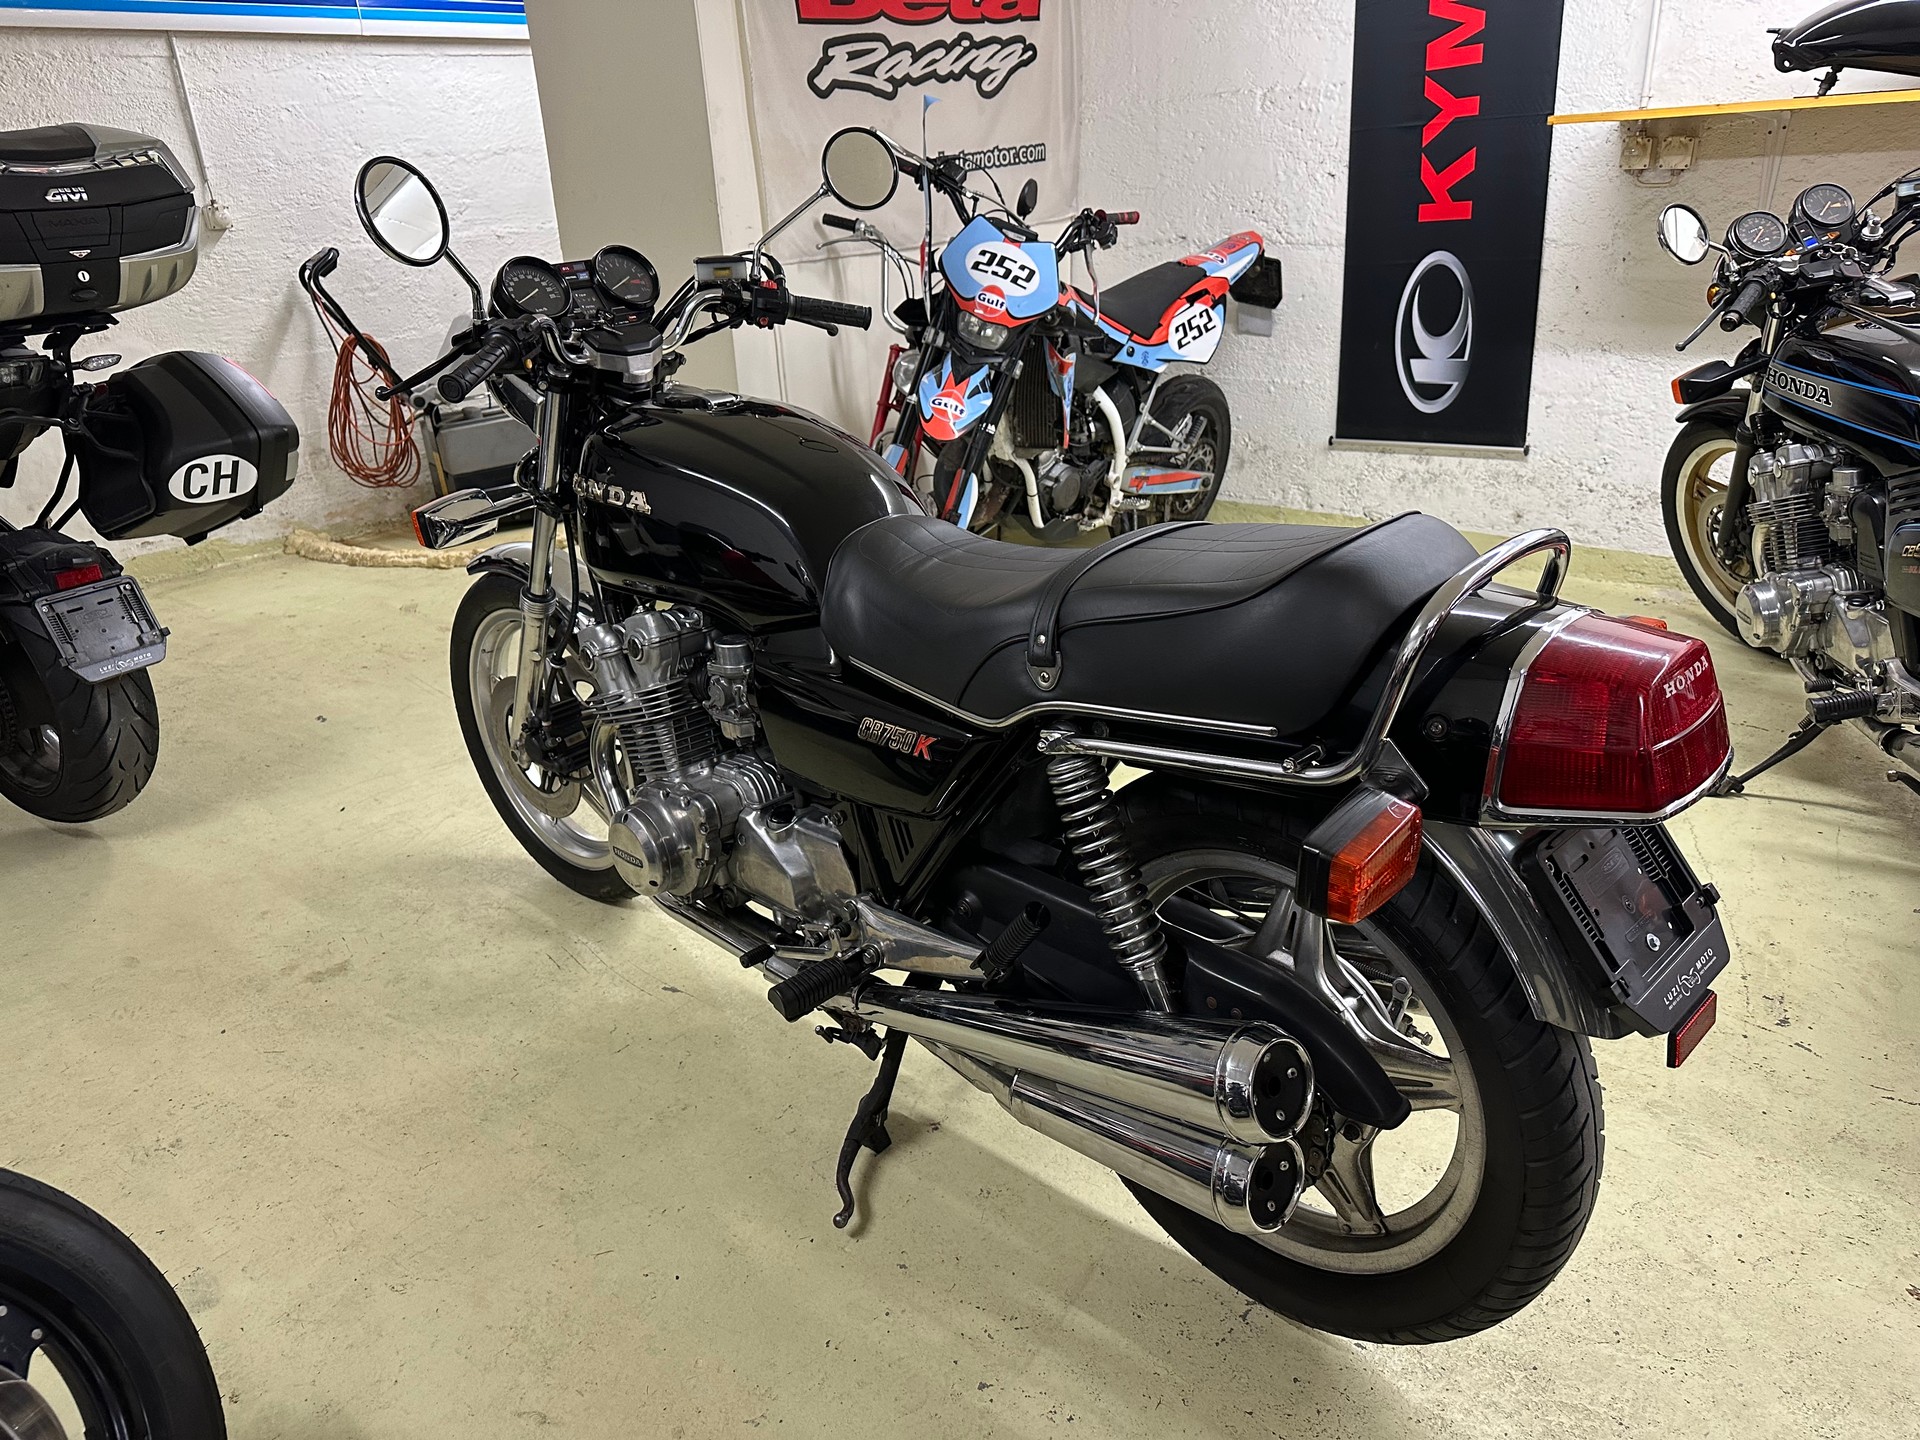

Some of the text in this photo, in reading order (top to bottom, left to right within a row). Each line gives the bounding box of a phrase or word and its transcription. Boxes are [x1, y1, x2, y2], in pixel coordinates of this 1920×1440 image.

[807, 32, 1037, 100] Racing
[937, 143, 1046, 172] tamotor.com
[45, 187, 89, 203] GIVI
[970, 249, 1036, 290] 252
[977, 292, 1006, 310] Gulf
[1174, 308, 1217, 350] 252
[1765, 366, 1833, 408] HONDA
[182, 460, 240, 499] CH
[572, 473, 652, 516] ONDA
[1663, 655, 1709, 698] HONDA
[614, 848, 642, 867] HONDA
[1663, 984, 1680, 1005] LUZI
[1695, 948, 1713, 970] MOTO
